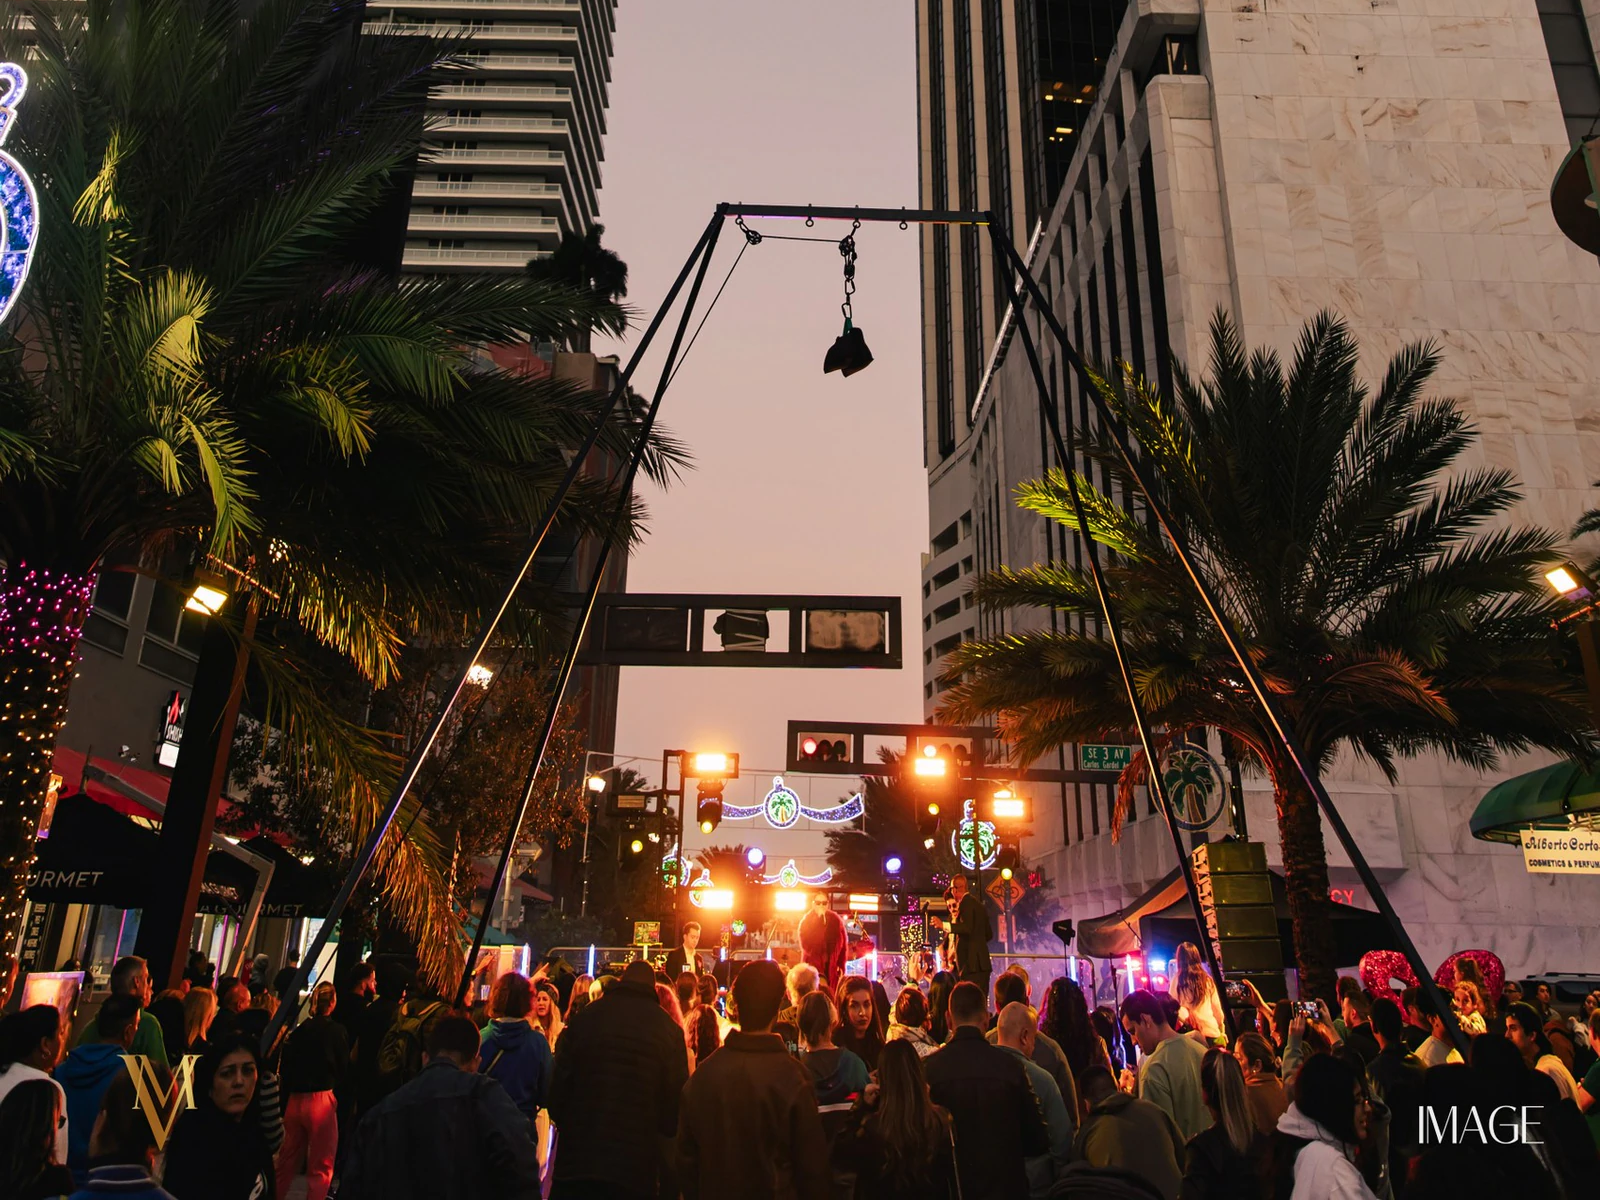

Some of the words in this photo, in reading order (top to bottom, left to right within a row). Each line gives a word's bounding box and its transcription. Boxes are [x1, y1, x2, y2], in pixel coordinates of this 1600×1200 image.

[1087, 747, 1098, 759] SE
[1102, 747, 1109, 760] 3
[1114, 748, 1124, 759] AV
[1083, 760, 1100, 769] Carlos
[1102, 760, 1120, 769] Gardel
[1525, 836, 1567, 851] Alberto
[1569, 837, 1600, 851] Corte
[1528, 859, 1566, 868] COSMETICS
[1567, 859, 1573, 868] &
[1574, 860, 1600, 869] PERFUM
[26, 869, 104, 889] URMET
[1330, 889, 1354, 905] CY
